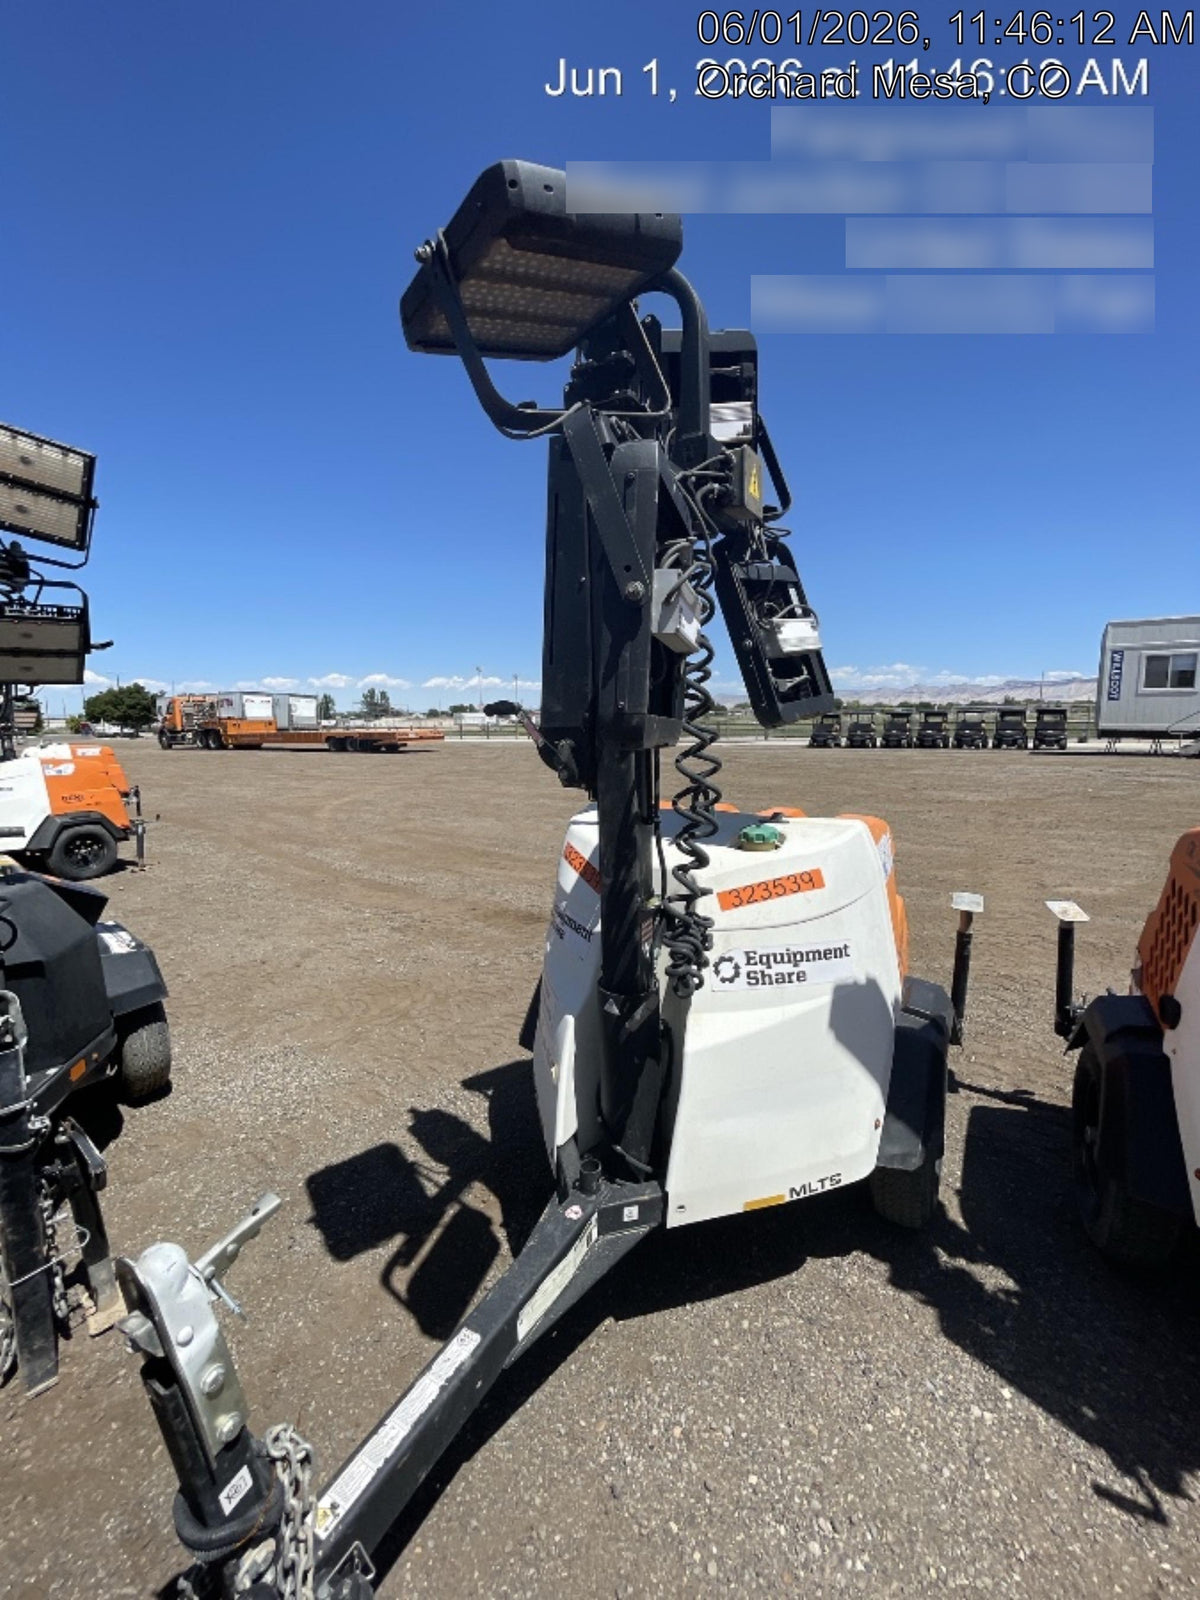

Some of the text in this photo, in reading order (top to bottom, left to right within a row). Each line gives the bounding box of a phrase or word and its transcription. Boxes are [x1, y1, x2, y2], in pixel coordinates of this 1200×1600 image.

[1109, 650, 1123, 700] WILLSCOT
[728, 871, 816, 908] 323539
[744, 943, 850, 969] Equipment
[746, 970, 807, 987] Share
